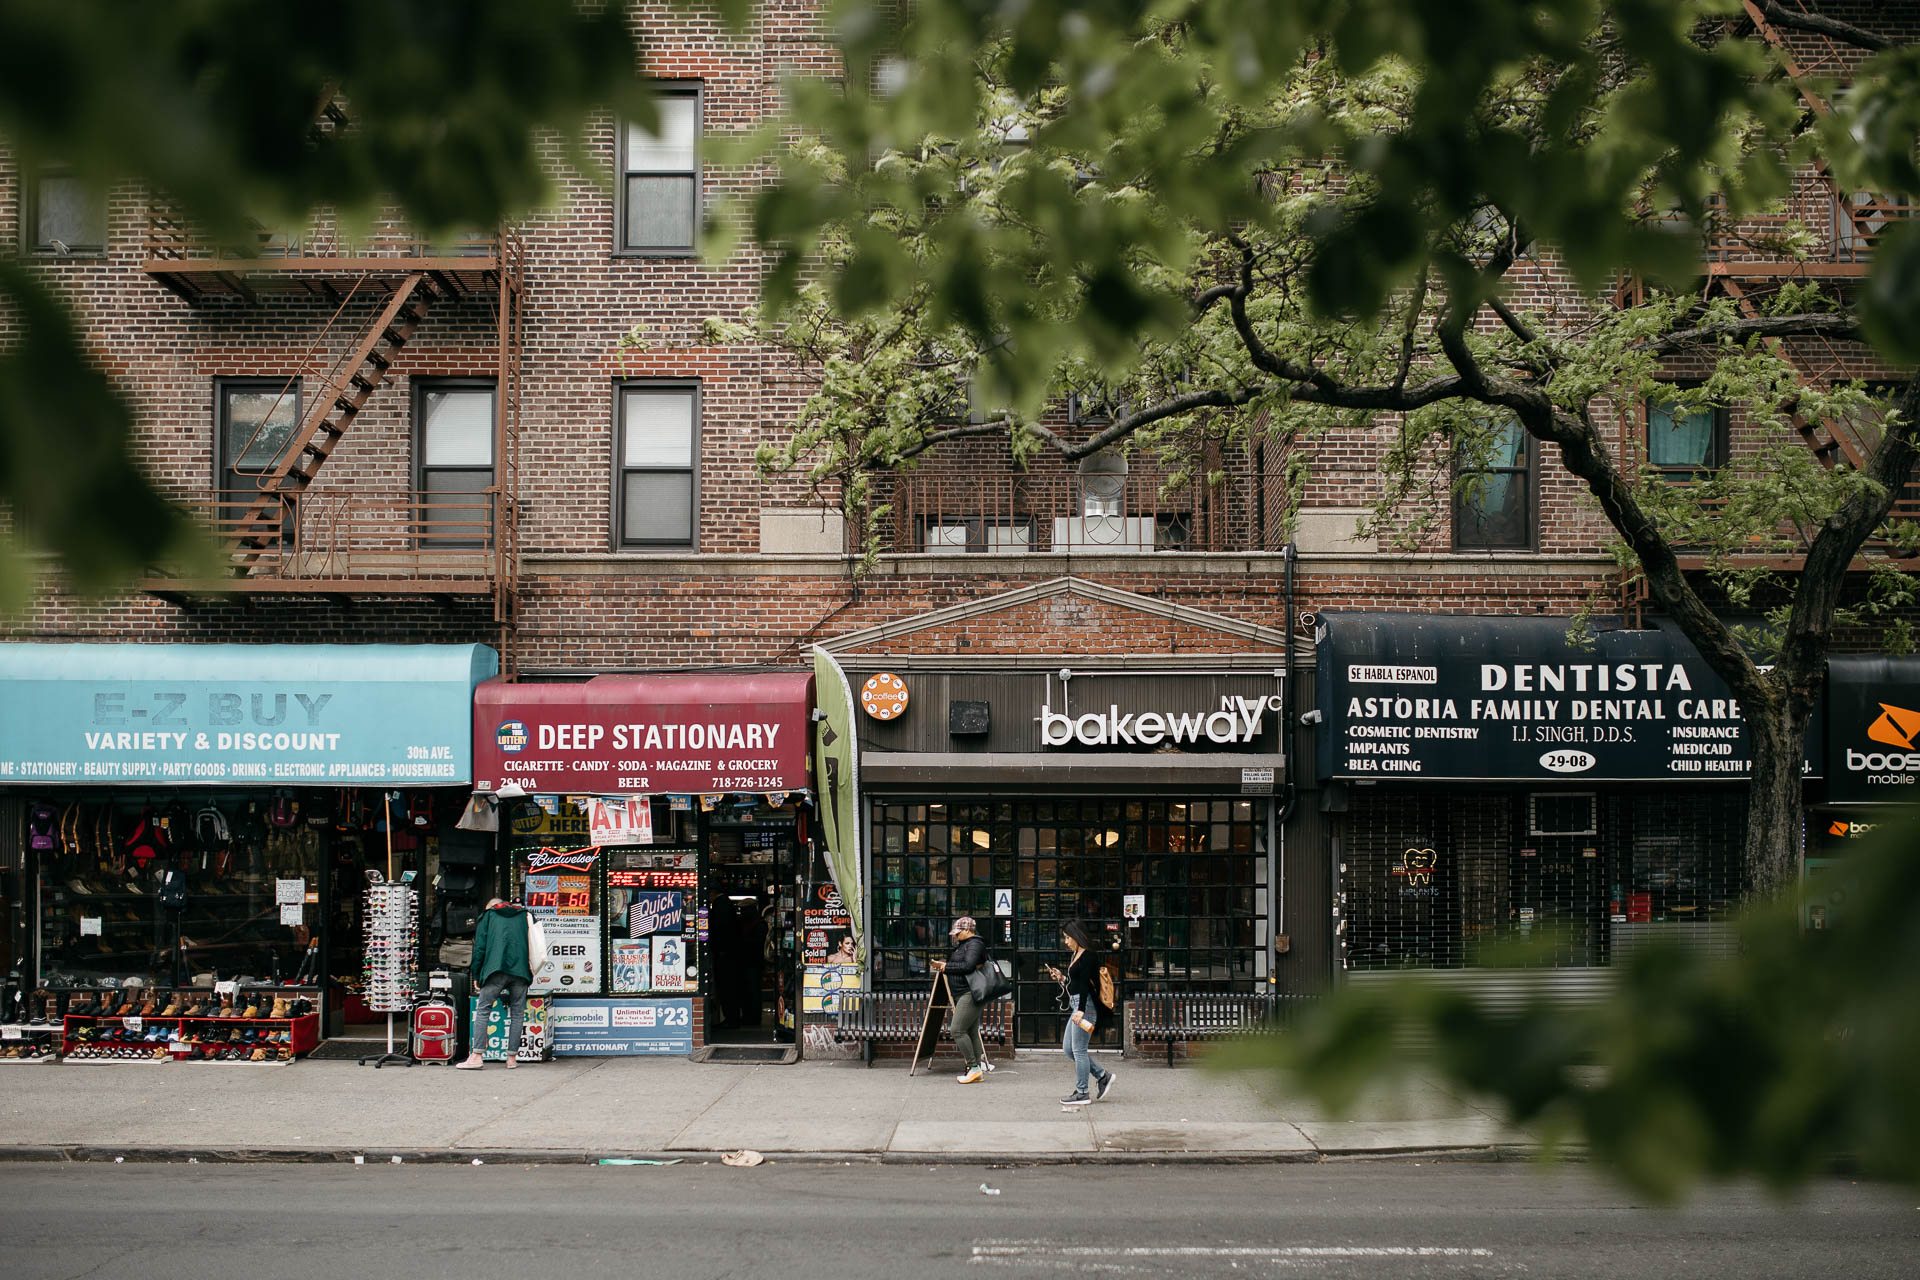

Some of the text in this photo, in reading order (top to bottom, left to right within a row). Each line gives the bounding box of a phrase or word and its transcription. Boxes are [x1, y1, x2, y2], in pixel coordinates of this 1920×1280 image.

[1350, 667, 1435, 681] SE HABLA ESPANOL
[1480, 664, 1692, 692] DENTISTA
[872, 692, 898, 701] coffee
[94, 692, 333, 726] E-Z BUY
[1347, 697, 1458, 719] ASTORIA
[1471, 699, 1560, 720] FAMILY
[1571, 699, 1666, 720] DENTAL
[1041, 695, 1269, 746] bakeway
[538, 723, 781, 751] DEEP STATIONARY
[1349, 725, 1480, 739] COSMETIC DENTISTRY
[1535, 726, 1589, 743] SINGH,
[1593, 726, 1637, 743] D.D.S.
[1672, 726, 1740, 739] INSURANCE
[85, 732, 340, 751] VARIETY & DISCOUNT
[497, 735, 528, 745] LOTTERY
[407, 746, 453, 760] 30th AVE.
[1349, 742, 1410, 755] IMPLANTS
[1672, 743, 1732, 755] MEDICAID
[504, 759, 779, 772] CIGARETTE CANDY SODA MAGAZINE & GROCERY
[1348, 758, 1421, 772] BLEA CHING
[1548, 755, 1587, 767] 29-08
[1671, 759, 1702, 772] CHILD
[1705, 760, 1743, 772] HEALTH
[21, 762, 77, 776] STATIONERY
[84, 762, 120, 775] BEAUTY
[121, 762, 156, 776] SUPPLY
[163, 762, 193, 776] PARTY
[194, 763, 225, 776] GOODS
[232, 763, 266, 777] DRINKS
[274, 763, 325, 777] ELECTRONIC
[328, 763, 385, 777] APPLIANCES
[392, 763, 455, 777] HOUSEWARES
[500, 777, 537, 789] 2910A
[618, 778, 650, 788] BEER
[712, 776, 783, 788] 718-726-1245
[1867, 774, 1915, 785] mobile
[592, 800, 650, 830] ATM
[549, 818, 590, 832] HERE
[527, 852, 600, 867] Budweiser
[531, 893, 558, 906] 174
[568, 893, 590, 907] 60
[640, 891, 675, 918] Quick
[997, 892, 1011, 909] A
[651, 908, 683, 933] Draw
[804, 916, 832, 925] Electronic
[552, 945, 586, 956] BEER
[804, 949, 820, 957] Sold
[655, 974, 682, 982] SLUSH
[574, 1043, 629, 1052] STATIONARY
